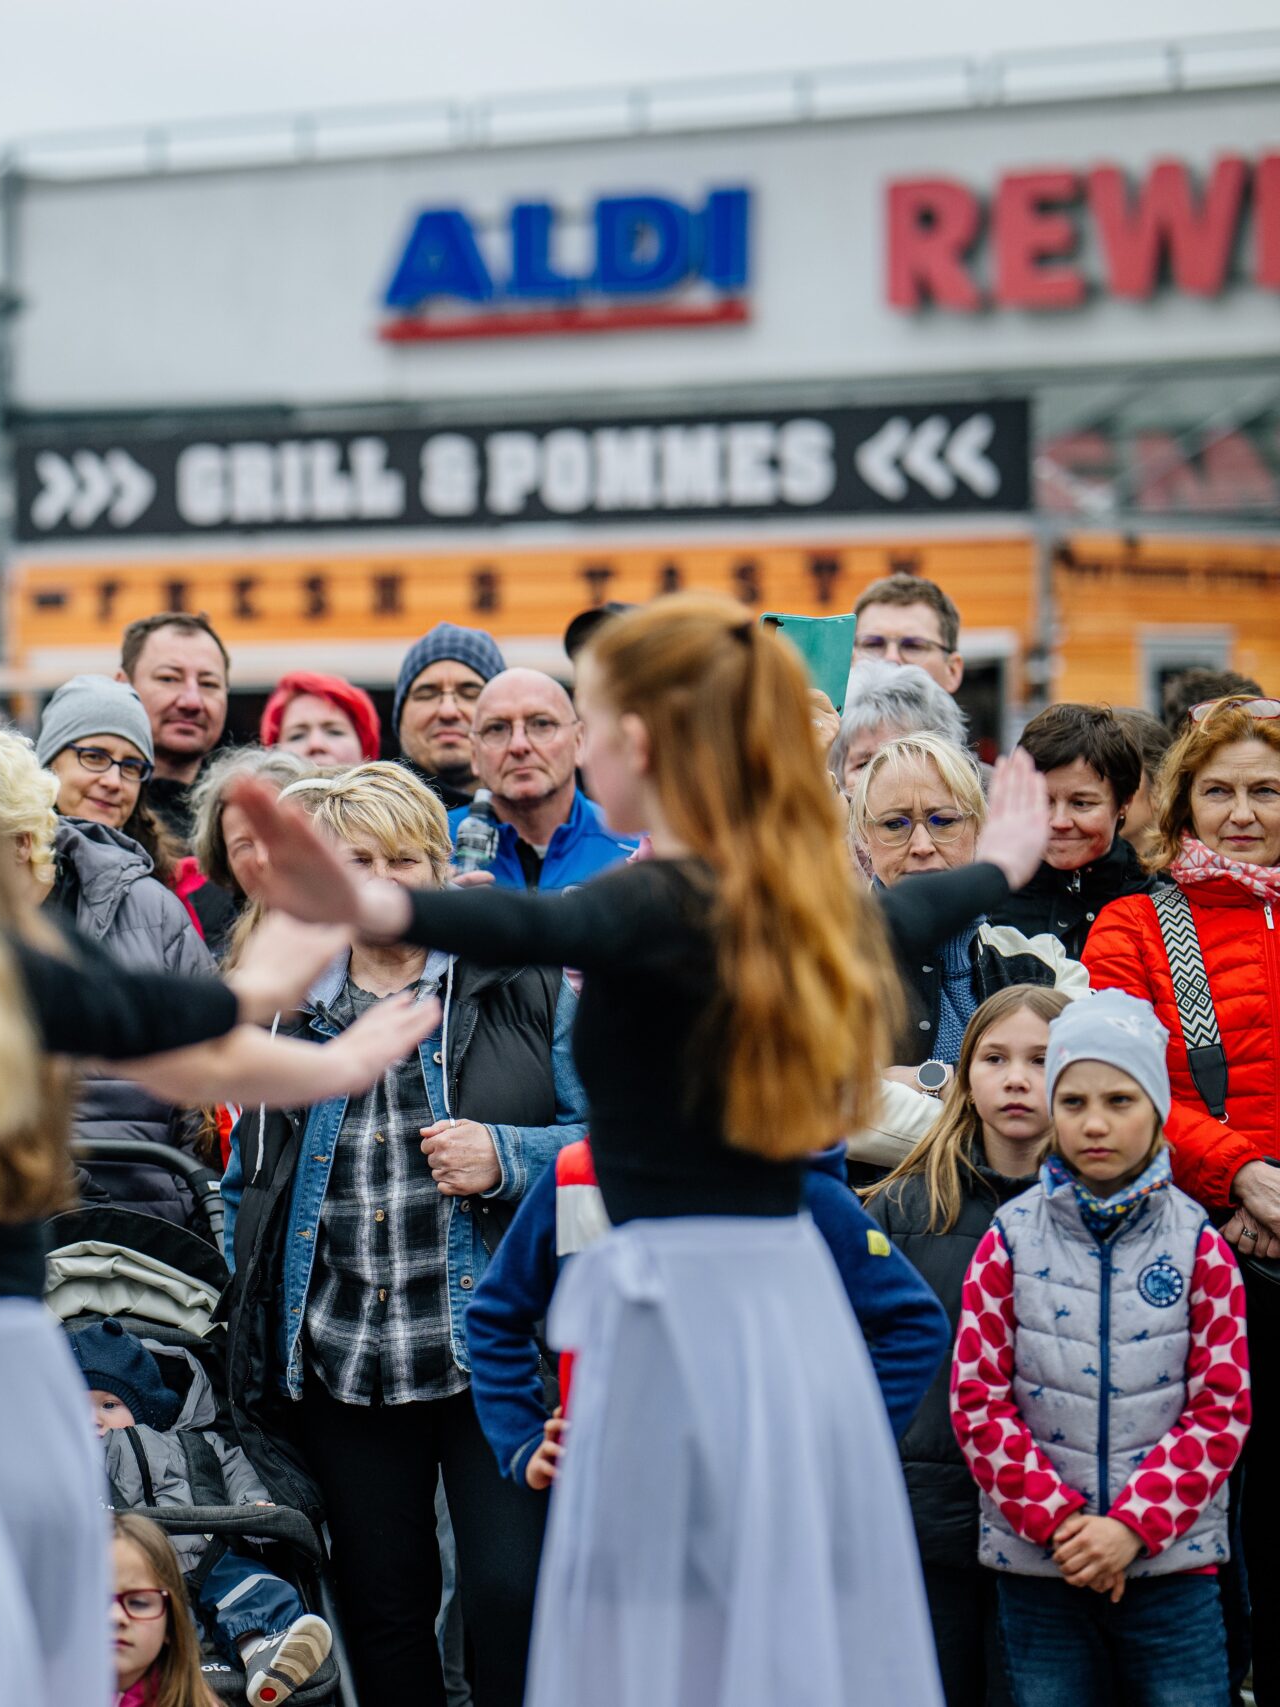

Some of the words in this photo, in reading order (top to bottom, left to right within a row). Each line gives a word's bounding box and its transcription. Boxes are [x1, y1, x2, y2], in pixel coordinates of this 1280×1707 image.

[384, 187, 750, 305] ALDI
[886, 148, 1280, 313] REW
[176, 438, 405, 525] GRILL
[420, 434, 479, 515] &
[486, 421, 835, 513] POMMES
[201, 1663, 231, 1671] oie
